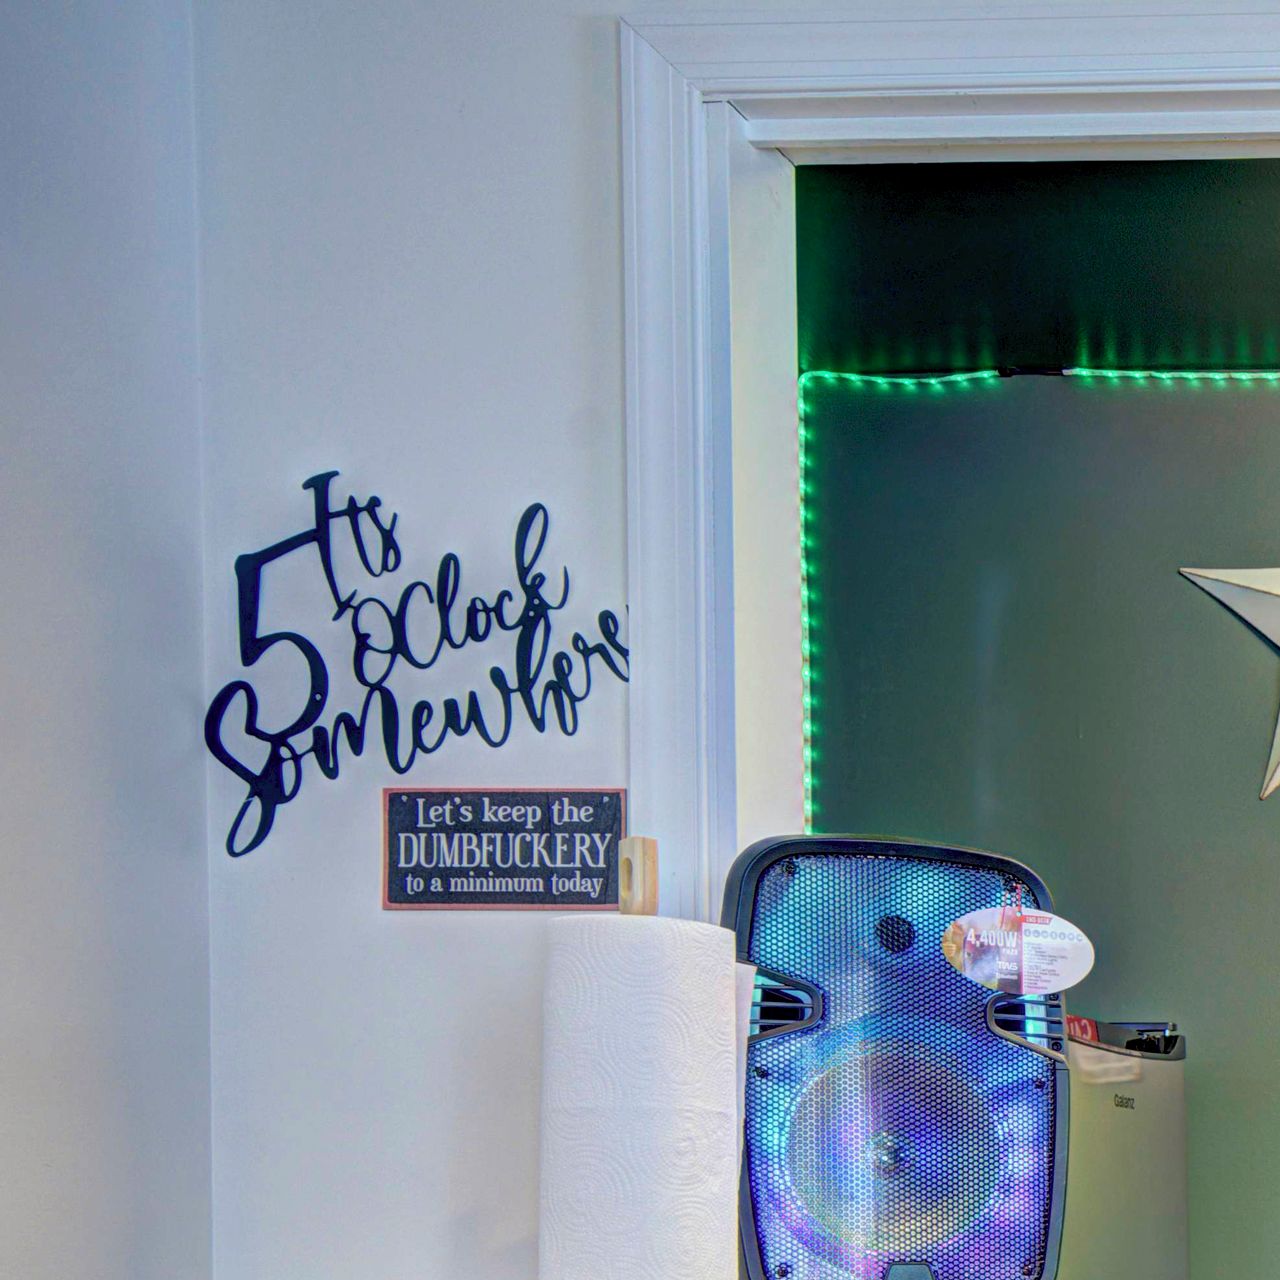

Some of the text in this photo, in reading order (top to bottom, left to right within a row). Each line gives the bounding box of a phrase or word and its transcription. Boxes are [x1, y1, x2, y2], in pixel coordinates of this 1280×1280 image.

[235, 525, 329, 738] 5
[416, 797, 595, 829] Let's keep the
[397, 832, 613, 868] DUMBFUCKERY
[406, 870, 604, 898] to a minimum today
[966, 927, 1018, 948] 4,400W
